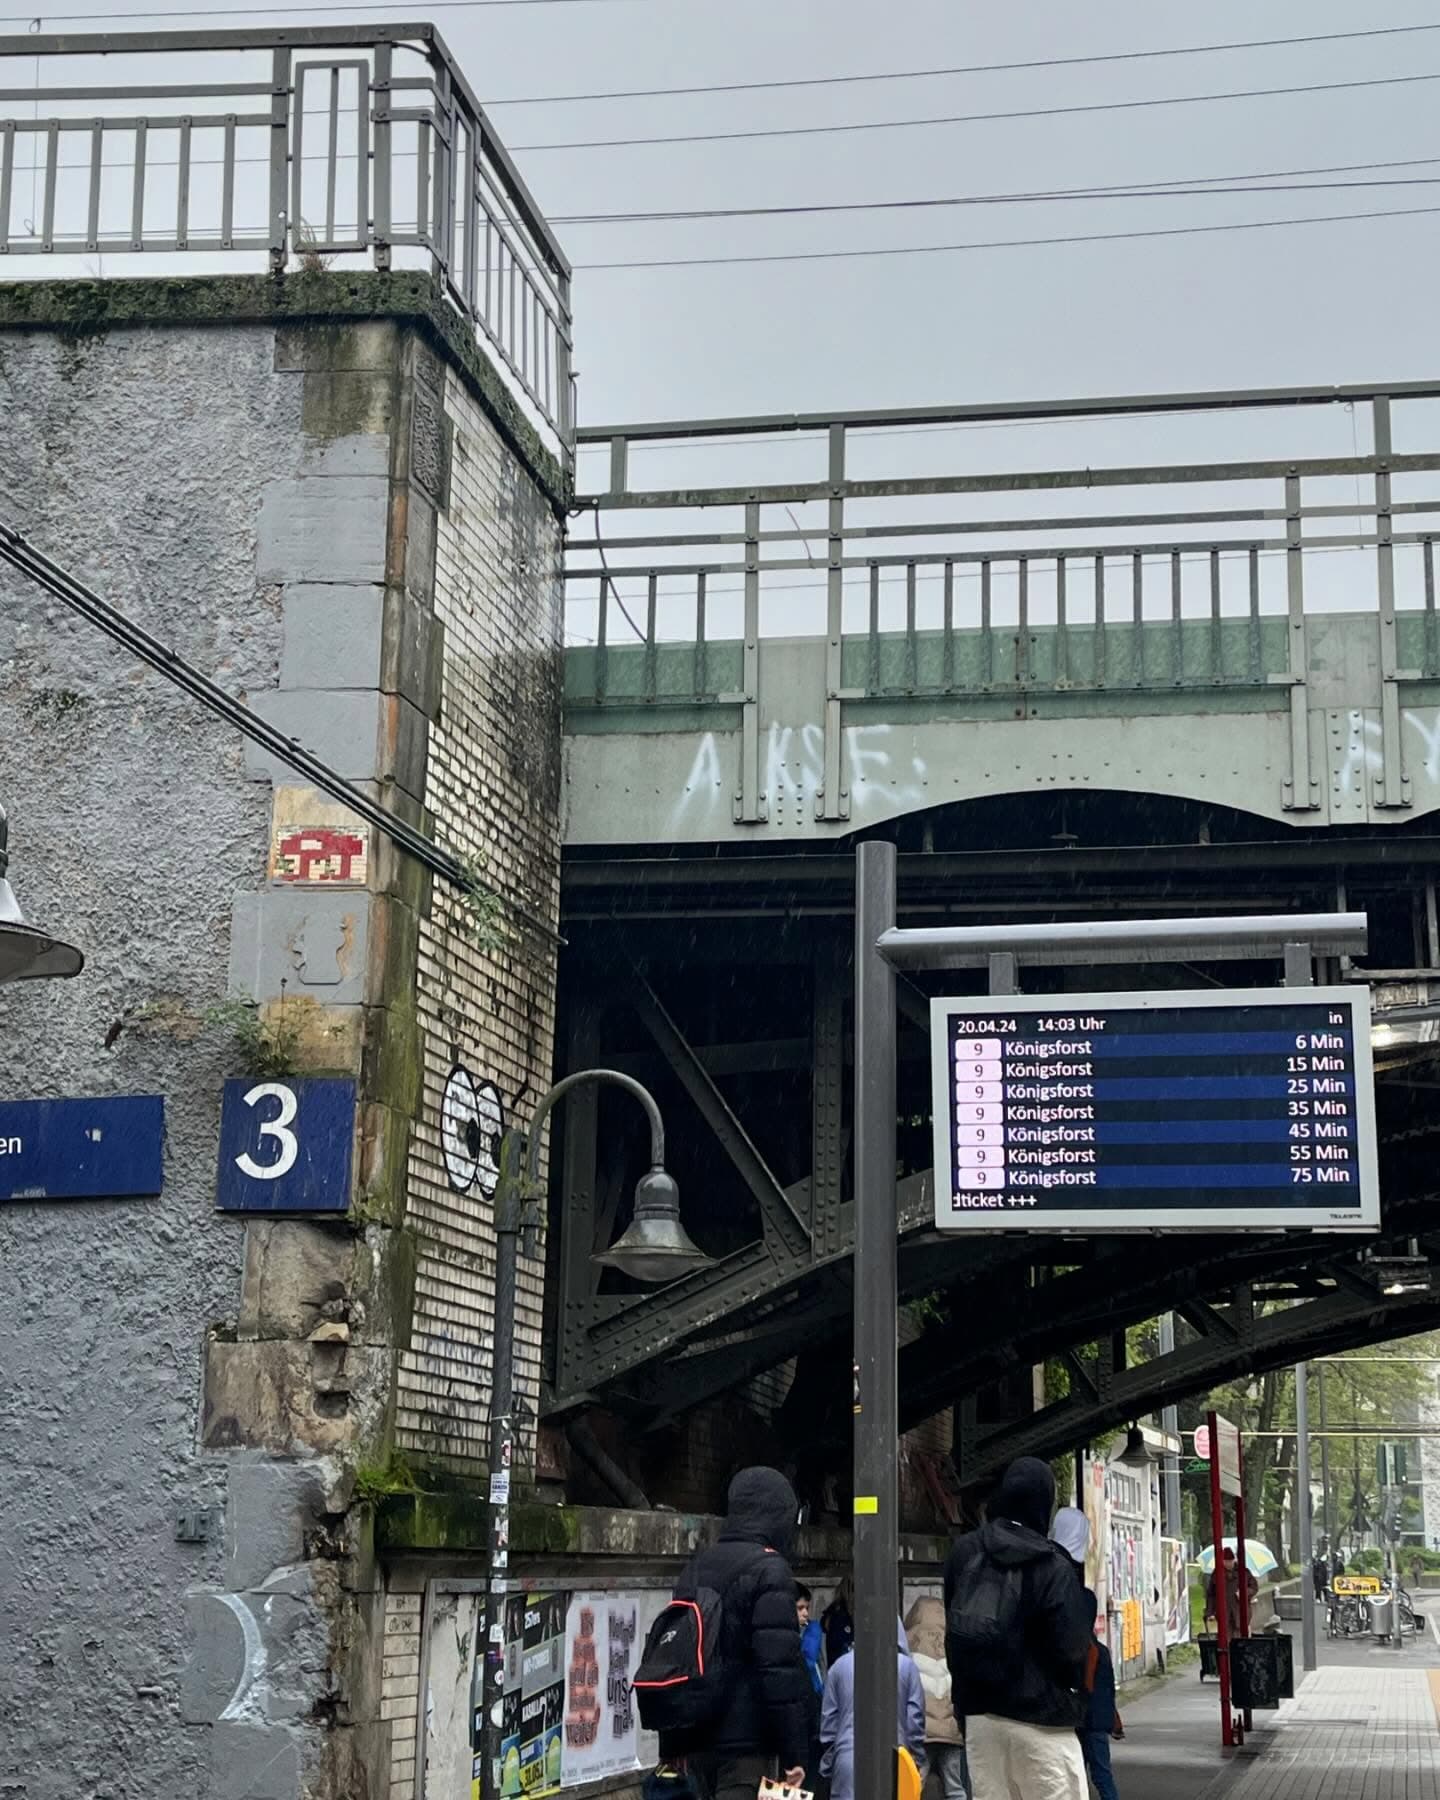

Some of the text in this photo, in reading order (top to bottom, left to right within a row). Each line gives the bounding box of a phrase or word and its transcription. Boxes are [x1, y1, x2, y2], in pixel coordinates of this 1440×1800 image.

[957, 1011, 1343, 1033] 20.04.24 14:03 Uhr in
[974, 1033, 1344, 1058] 9 Königsforst 6 Min
[974, 1055, 1345, 1079] 9 Königsforst 15 Min
[975, 1077, 1346, 1101] 9 Königsforst 25 Min
[976, 1100, 1347, 1123] 9 Königsforst 35 Min
[235, 1082, 298, 1179] 3
[976, 1122, 1348, 1144] 9 Königsforst 45 Min
[977, 1144, 1349, 1166] 9 Königsforst 55 Min
[978, 1166, 1350, 1188] 9 Königsforst 75 Min
